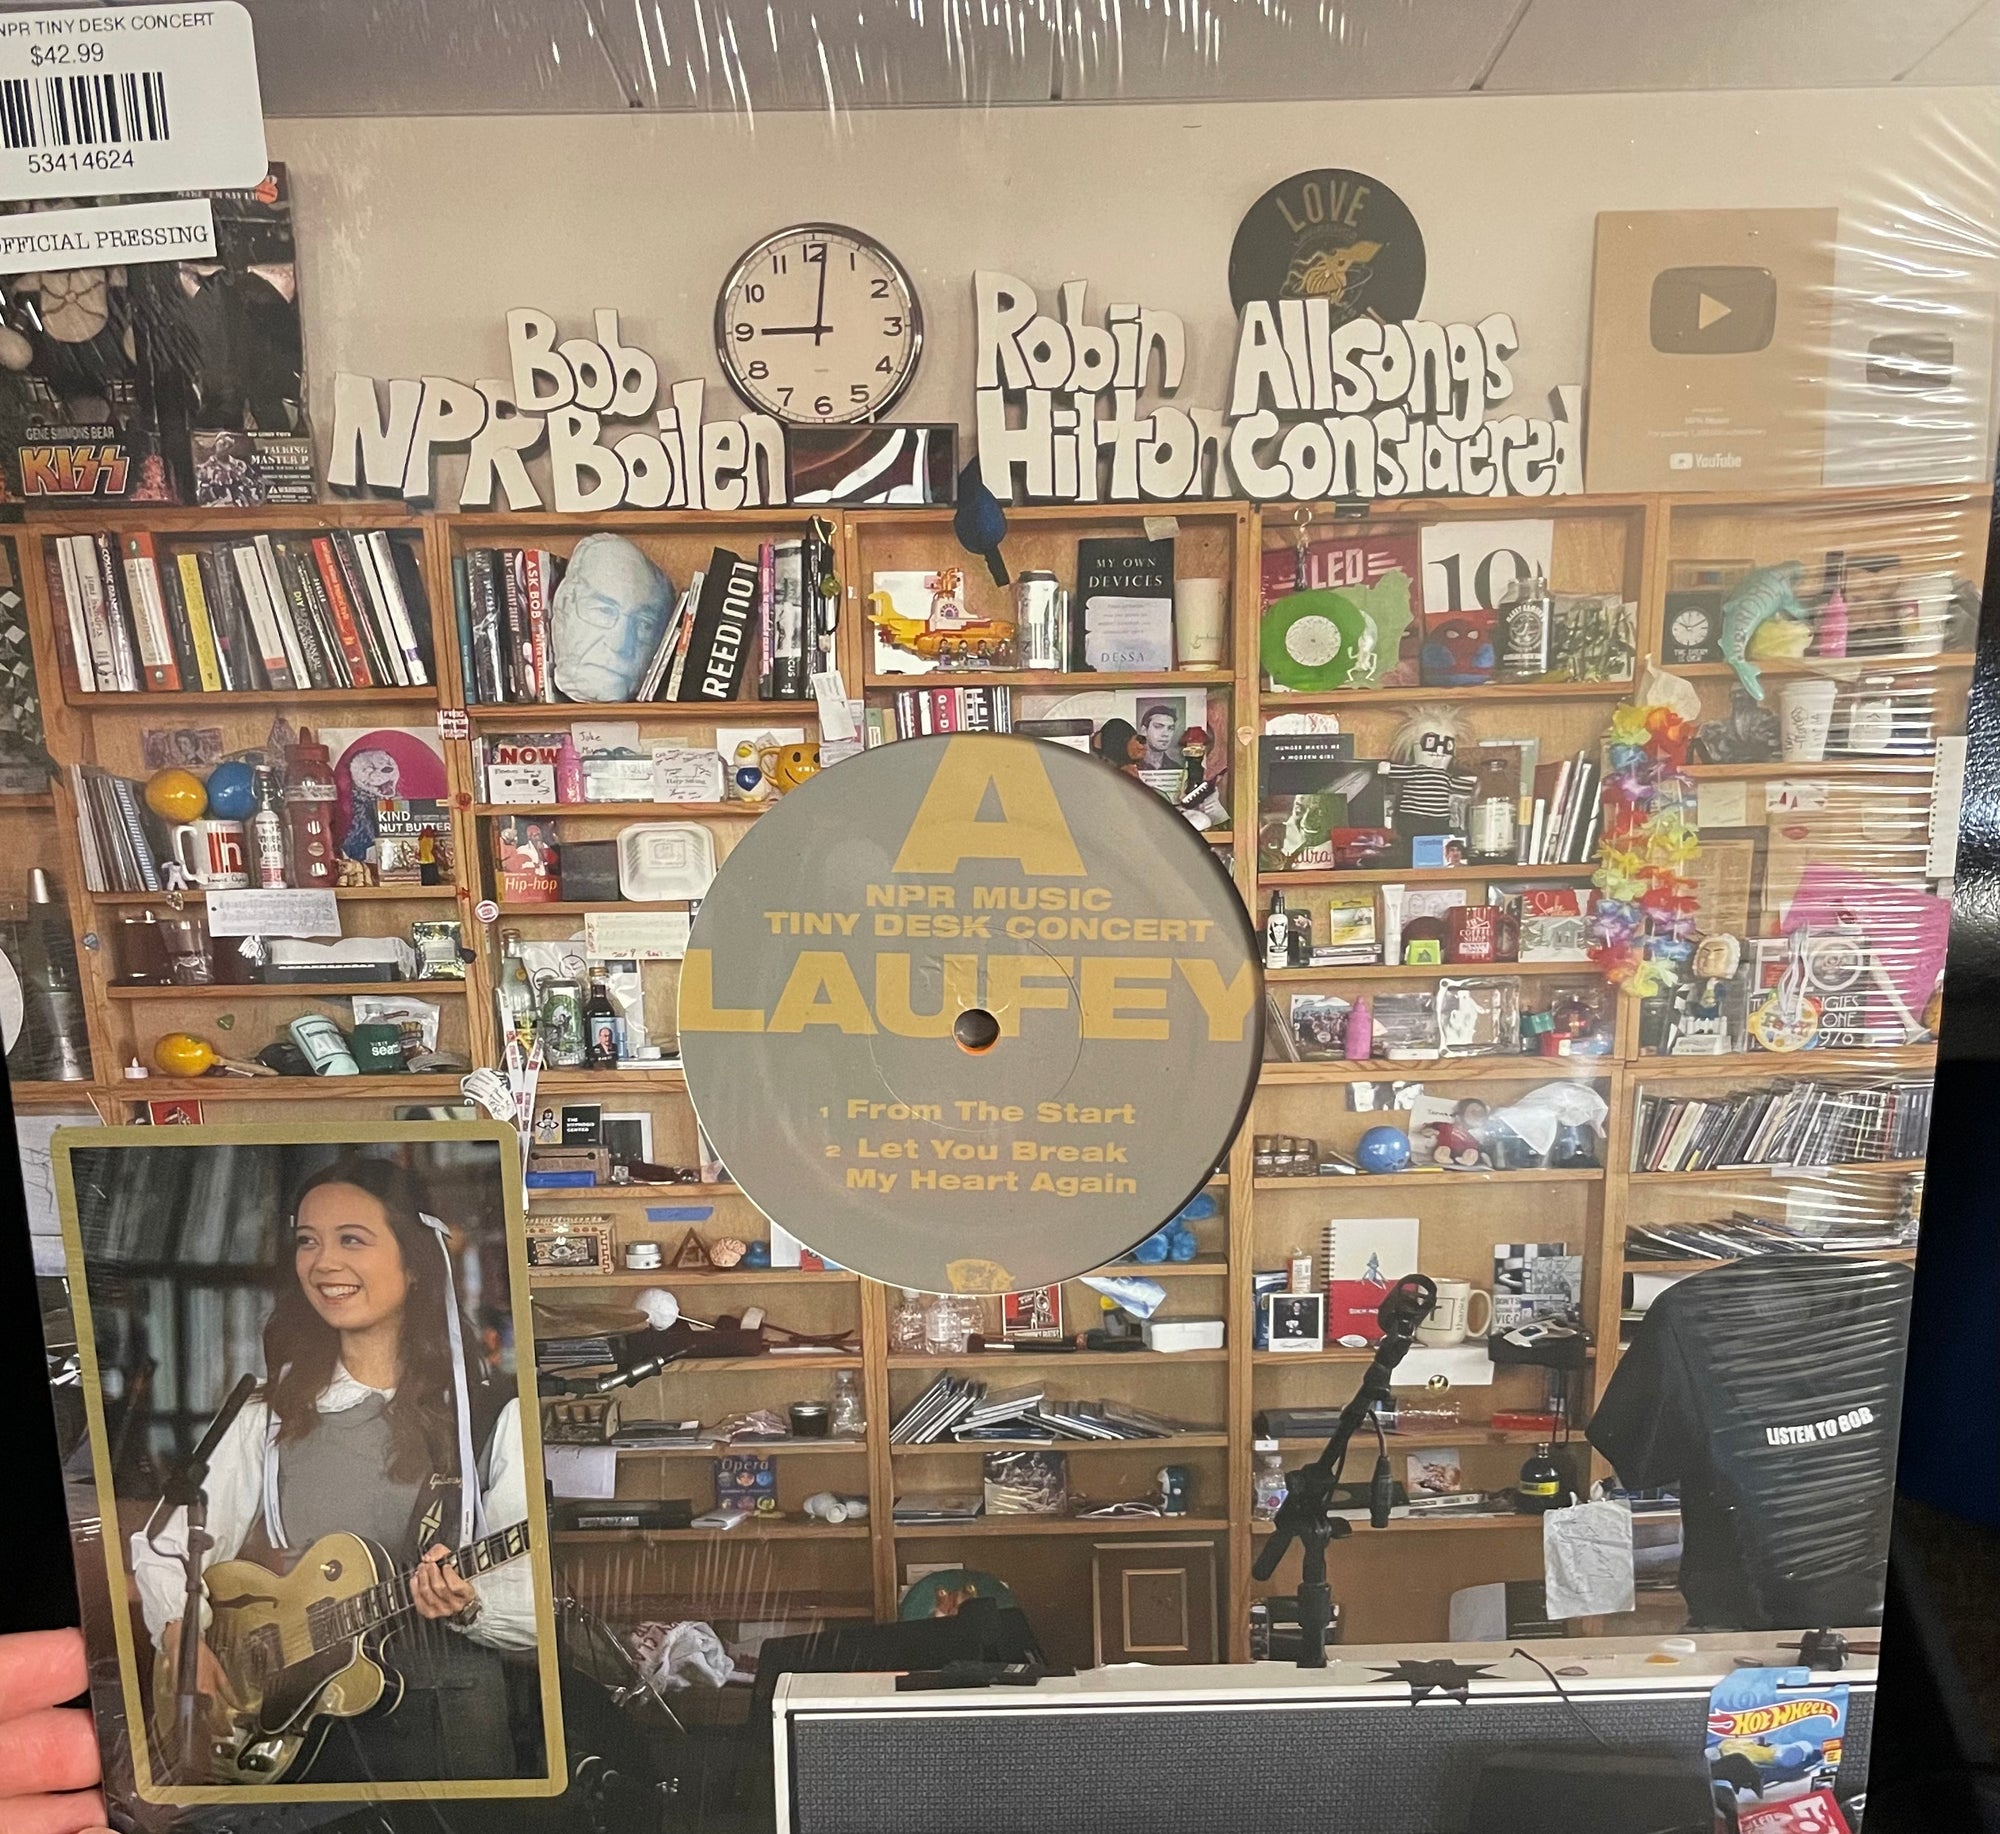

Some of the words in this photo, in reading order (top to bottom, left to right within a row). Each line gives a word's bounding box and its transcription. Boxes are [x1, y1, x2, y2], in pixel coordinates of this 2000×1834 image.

[35, 19, 76, 35] TINY
[79, 17, 127, 33] DESK
[131, 12, 214, 31] CONCERT
[30, 42, 104, 67] $42.99
[28, 149, 135, 174] 53414624
[1275, 180, 1371, 232] LOVE
[95, 225, 209, 248] PRESSING
[772, 255, 787, 274] 11
[803, 243, 826, 263] 12
[850, 252, 856, 271] 1
[745, 284, 765, 303] 10
[870, 279, 889, 299] 2
[735, 322, 755, 342] 9
[883, 316, 903, 336] 3
[973, 269, 1186, 391] Robin
[506, 306, 659, 419] Bob
[748, 360, 770, 380] 8
[875, 355, 894, 375] 4
[777, 387, 794, 407] 7
[814, 395, 833, 415] 6
[850, 384, 870, 403] 5
[26, 427, 50, 441] GENE
[91, 425, 115, 439] BEAR
[327, 371, 550, 511] NPR
[976, 384, 1234, 501] Hilton
[548, 377, 787, 513] Boilen
[18, 444, 131, 496] KISS
[250, 454, 299, 465] MASTER
[1695, 452, 1742, 468] YouTube
[101, 548, 115, 586] COSMIC
[1096, 557, 1117, 569] MY
[1123, 556, 1156, 568] OWN
[1310, 548, 1363, 589] LED
[526, 560, 540, 589] ASK
[1089, 574, 1163, 589] DEVICES
[529, 591, 542, 619] BOB
[293, 590, 305, 607] DIY
[307, 634, 323, 669] MANUAL
[702, 625, 743, 698] REED
[1101, 651, 1145, 663] DESSA
[500, 747, 560, 765] NOW
[377, 810, 411, 822] KIND
[891, 733, 1088, 877] A
[378, 822, 403, 833] NUT
[405, 821, 452, 833] BUTTER
[504, 876, 558, 895] Hip-hop
[866, 884, 955, 909] NPR
[973, 886, 1113, 912] MUSIC
[764, 911, 862, 936] TINY
[874, 914, 993, 939] DESK
[1006, 917, 1215, 943] CONCERT
[678, 947, 1258, 1042] LAUFEY
[820, 1106, 829, 1118] 1
[847, 1099, 943, 1121] From
[954, 1101, 1024, 1122] The
[1037, 1102, 1136, 1124] Start
[825, 1144, 841, 1158] 2
[858, 1138, 919, 1159] Let
[931, 1139, 998, 1161] You
[1011, 1141, 1128, 1163] Break
[846, 1168, 898, 1193] My
[910, 1169, 1019, 1192] Heart
[1030, 1171, 1137, 1197] Again
[1765, 1424, 1817, 1446] LISTEN
[1815, 1418, 1838, 1439] TO
[1838, 1406, 1874, 1433] BOB
[721, 1457, 769, 1473] Opera
